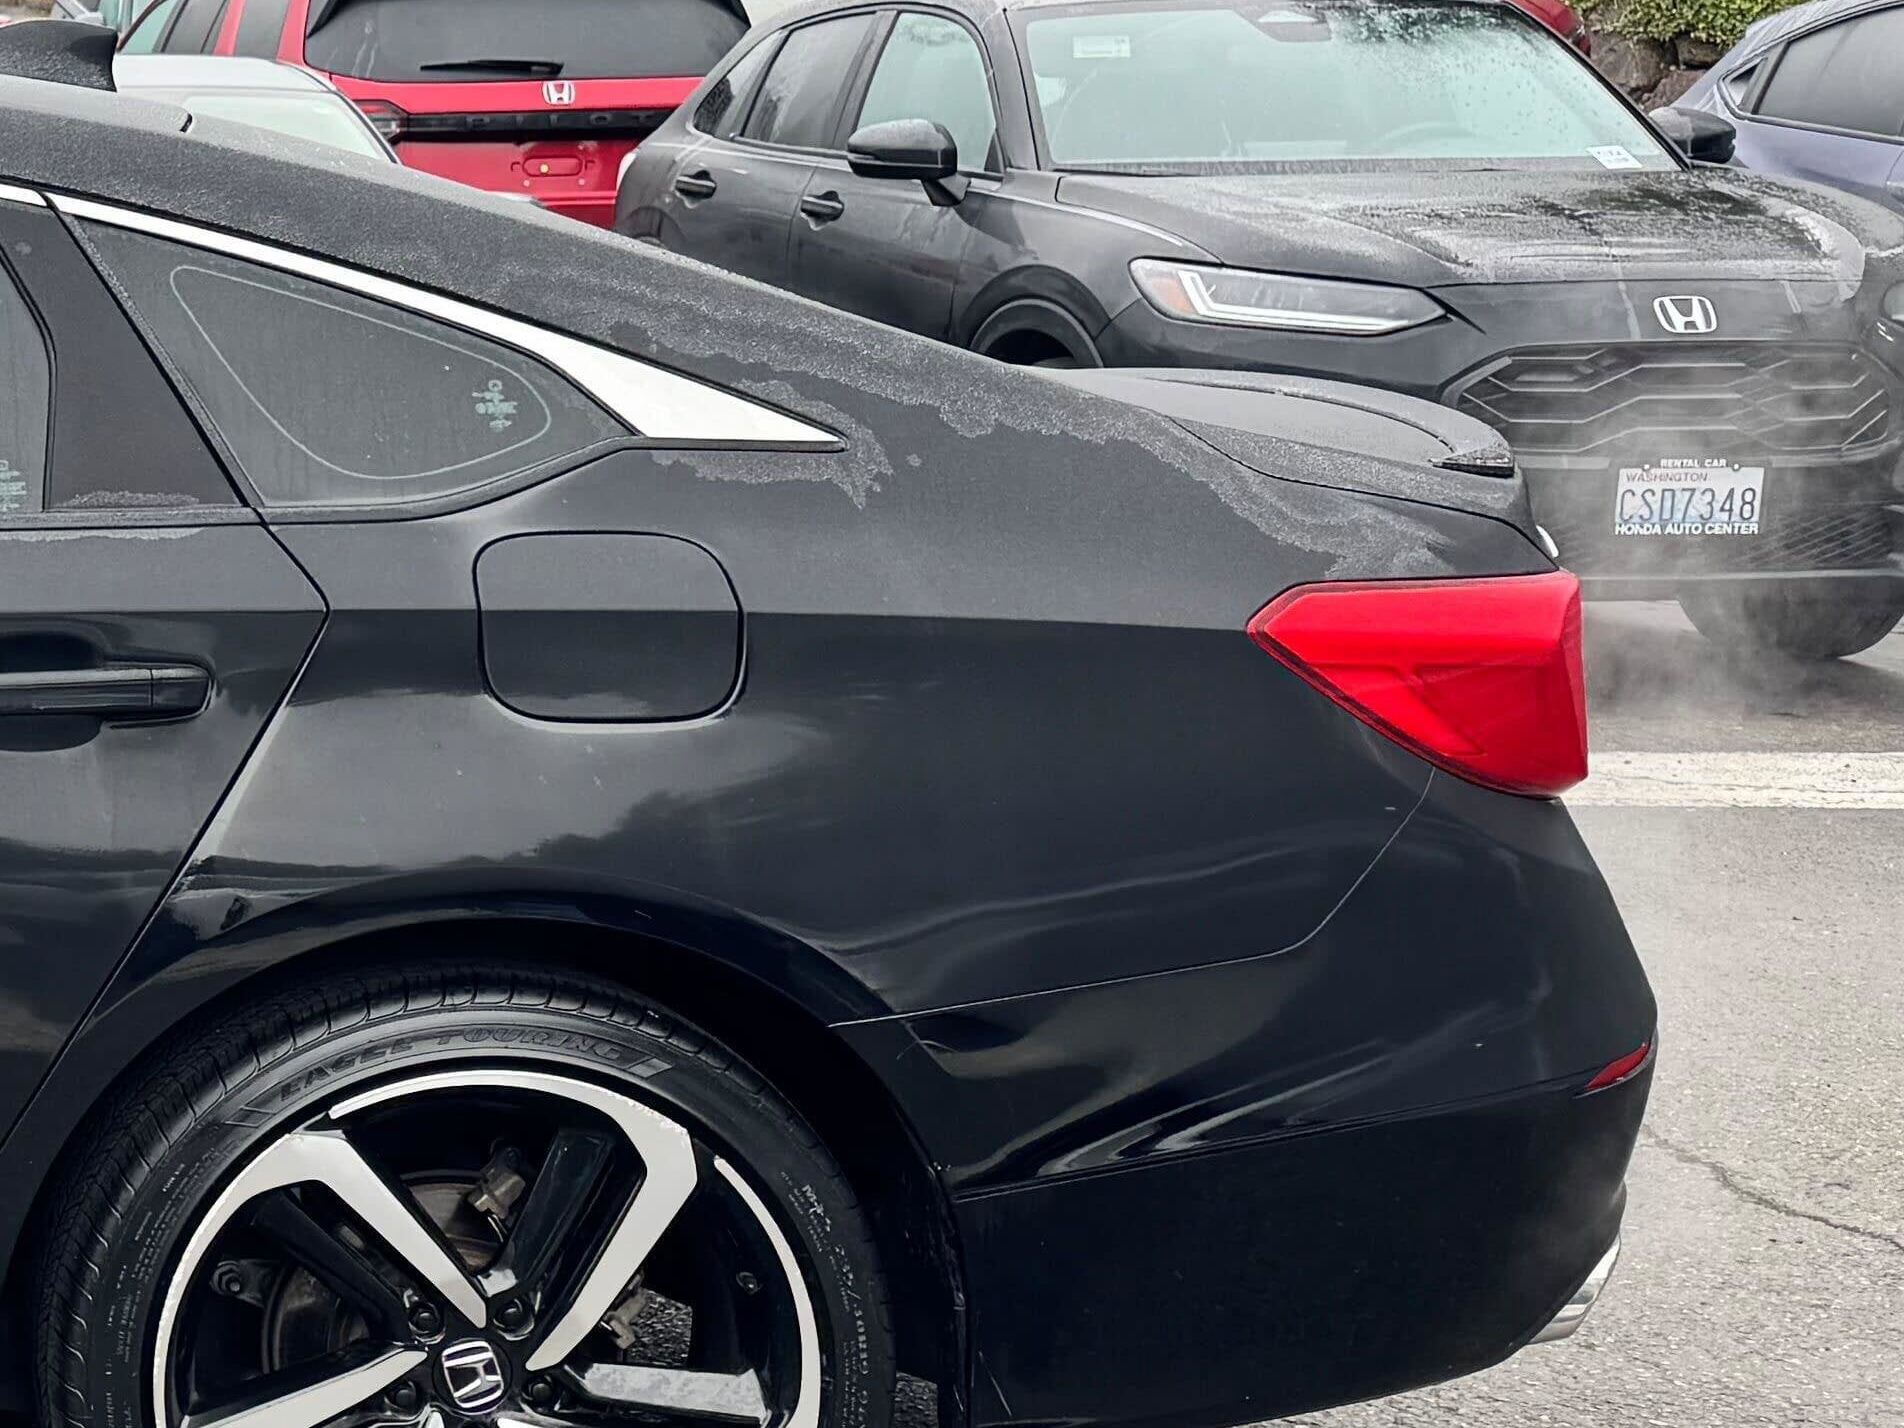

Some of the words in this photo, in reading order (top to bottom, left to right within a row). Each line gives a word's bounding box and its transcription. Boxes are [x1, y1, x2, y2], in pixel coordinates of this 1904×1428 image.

[1660, 458, 1700, 468] RENTAL
[1704, 458, 1727, 468] CAR
[1625, 472, 1709, 483] WASHINGTON
[1619, 487, 1757, 522] CSD7348
[1615, 523, 1661, 536] HONDA
[1663, 523, 1703, 535] AUTO
[1704, 522, 1759, 535] CENTER
